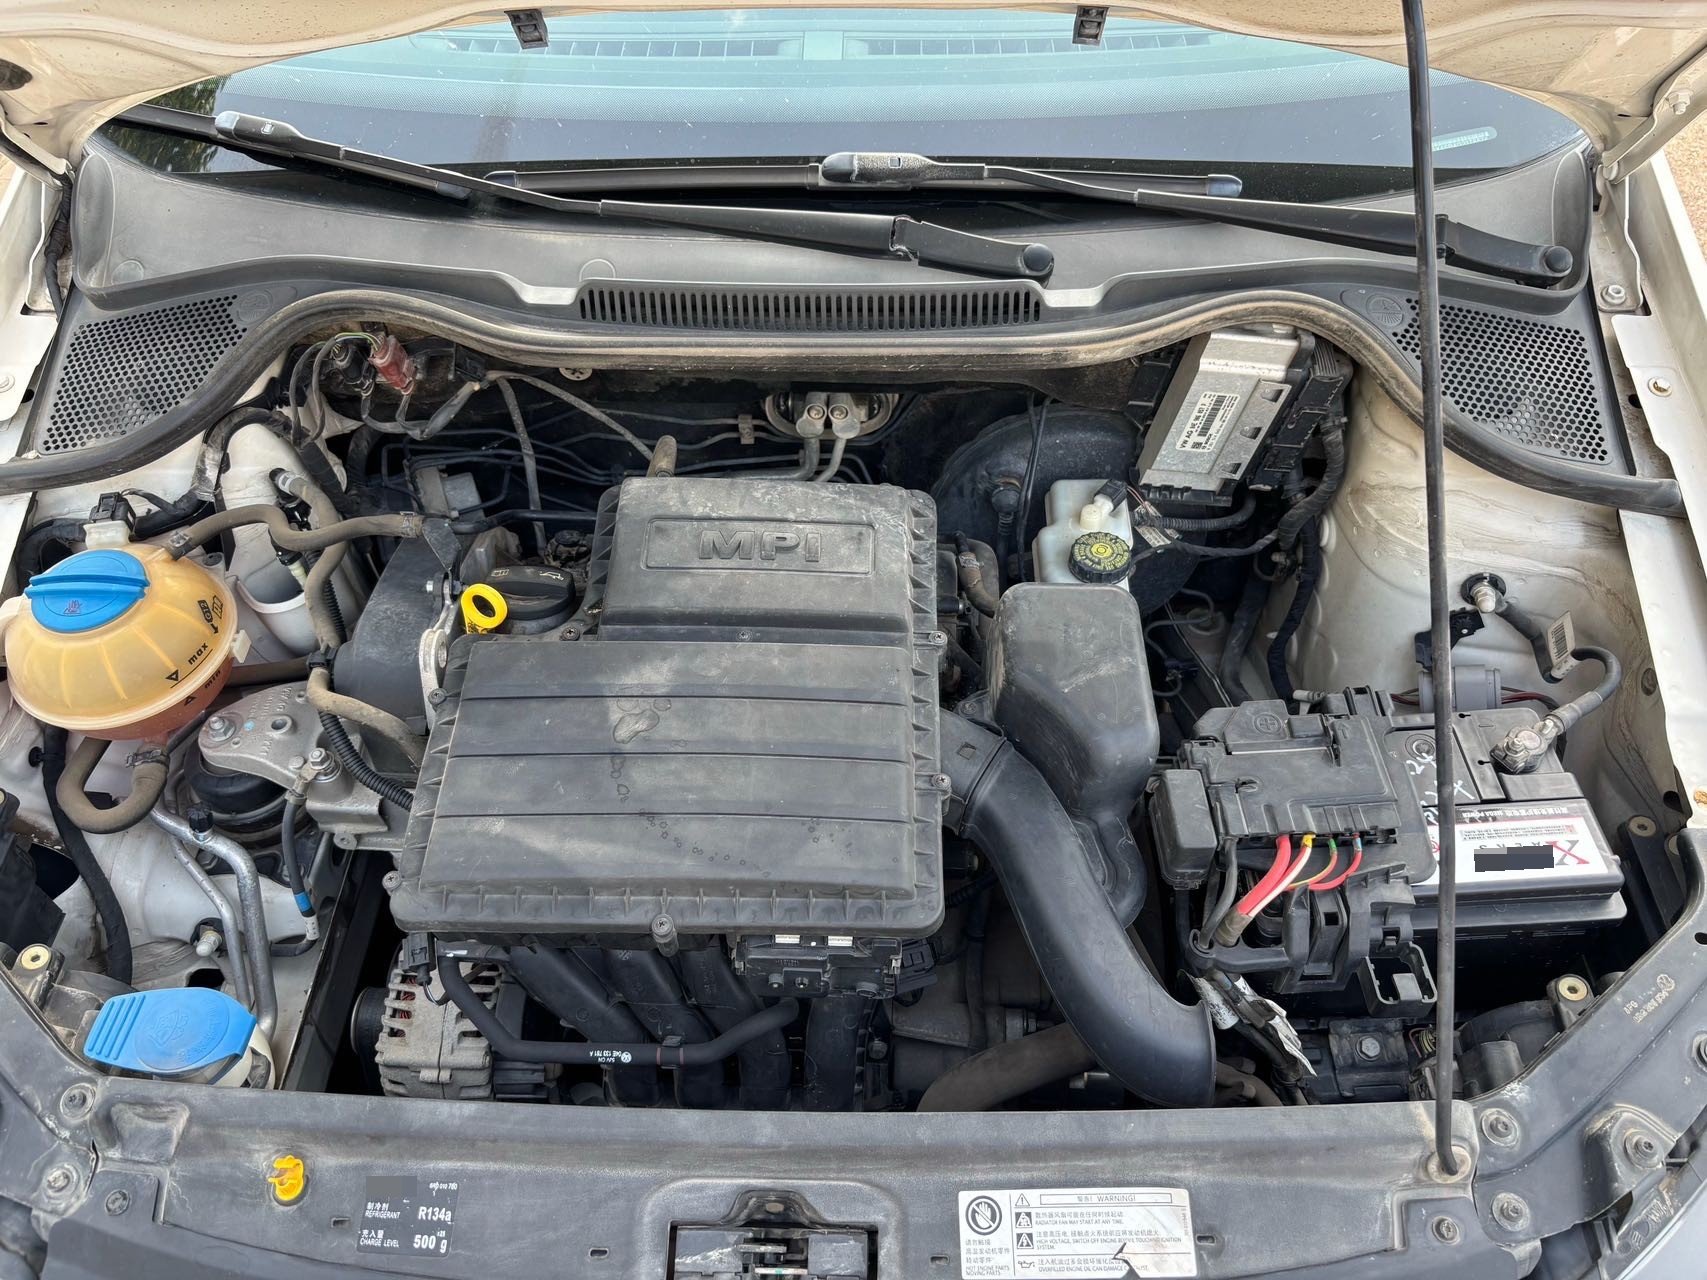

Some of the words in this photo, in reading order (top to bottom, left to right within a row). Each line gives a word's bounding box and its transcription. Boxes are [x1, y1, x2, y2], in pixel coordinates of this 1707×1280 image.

[699, 530, 821, 562] MPI
[188, 643, 208, 665] max
[204, 670, 220, 689] min
[365, 1210, 400, 1219] REFRIGERANT
[418, 1206, 452, 1221] R134a
[360, 1238, 381, 1247] CHARGE
[384, 1239, 399, 1248] LEVEL
[413, 1235, 436, 1249] 500
[440, 1239, 447, 1253] g
